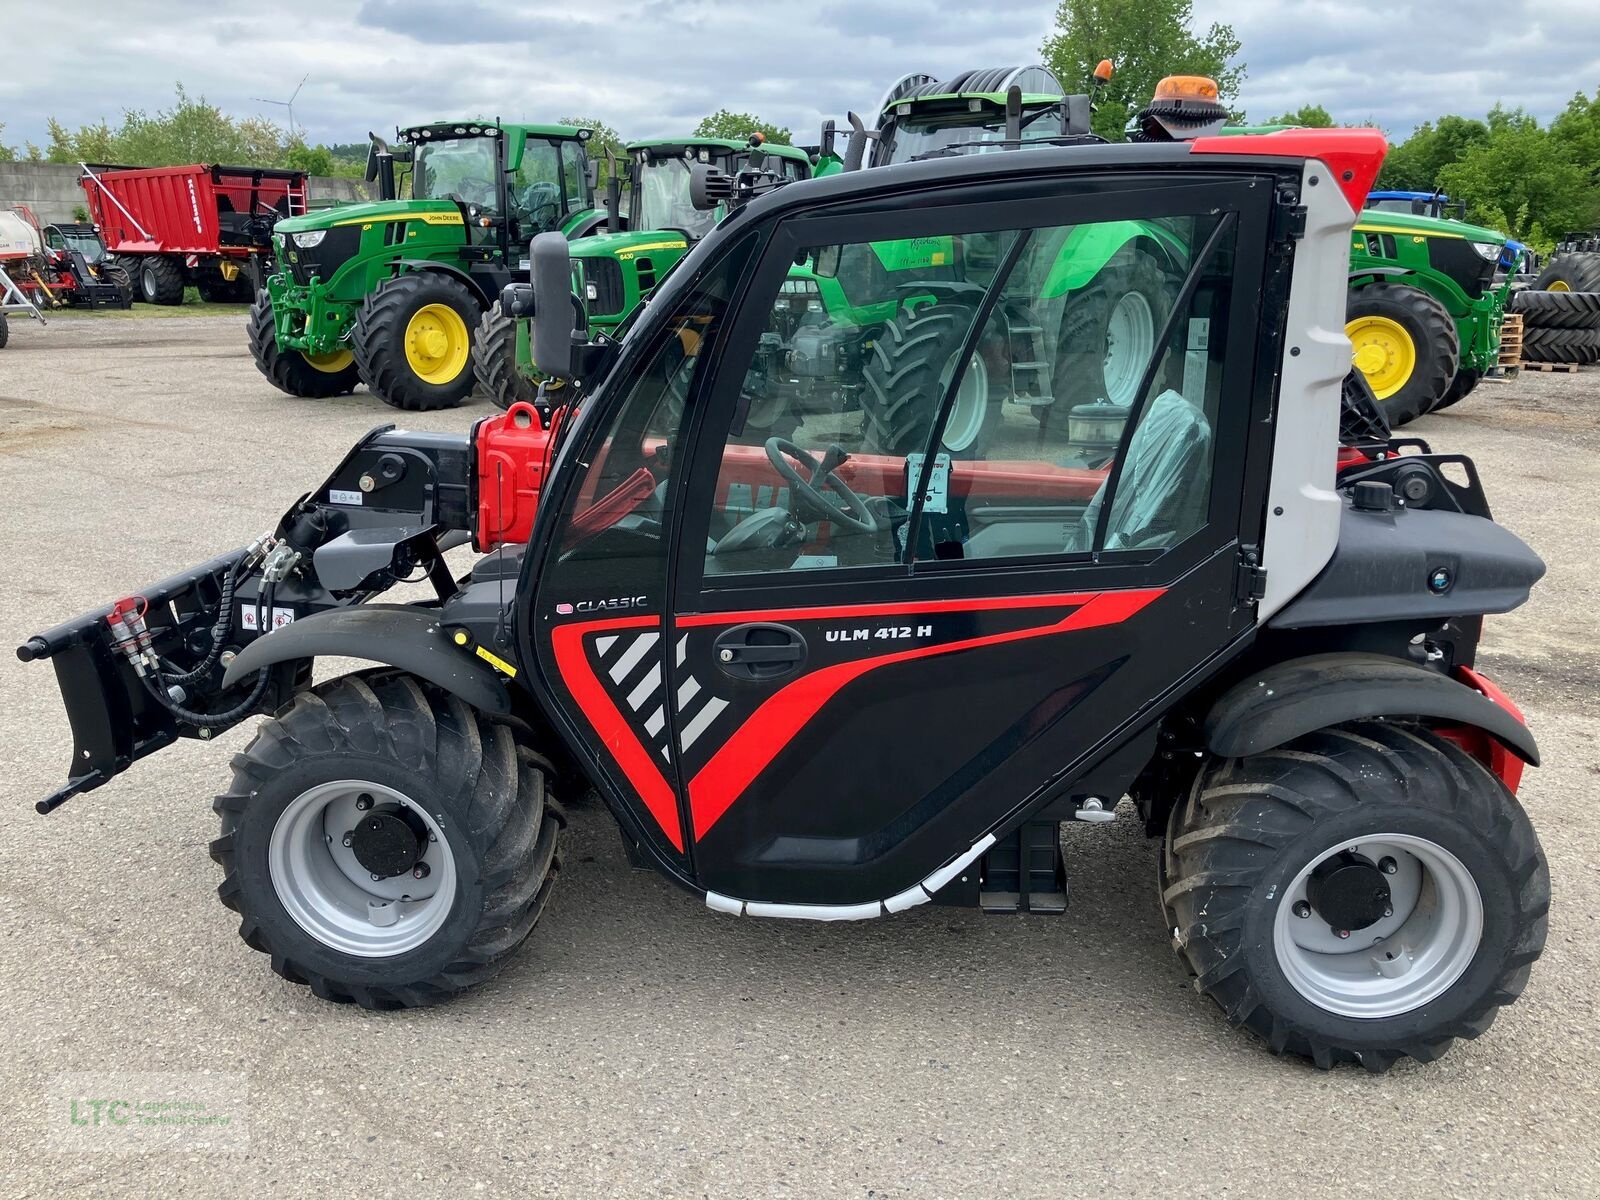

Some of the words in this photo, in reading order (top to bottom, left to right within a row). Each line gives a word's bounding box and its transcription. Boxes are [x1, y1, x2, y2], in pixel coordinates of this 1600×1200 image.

[187, 179, 202, 234] Krampe
[620, 253, 634, 261] 6430
[576, 595, 648, 613] CLASSIC
[825, 628, 870, 642] ULM
[874, 626, 912, 640] 412
[916, 625, 933, 637] H
